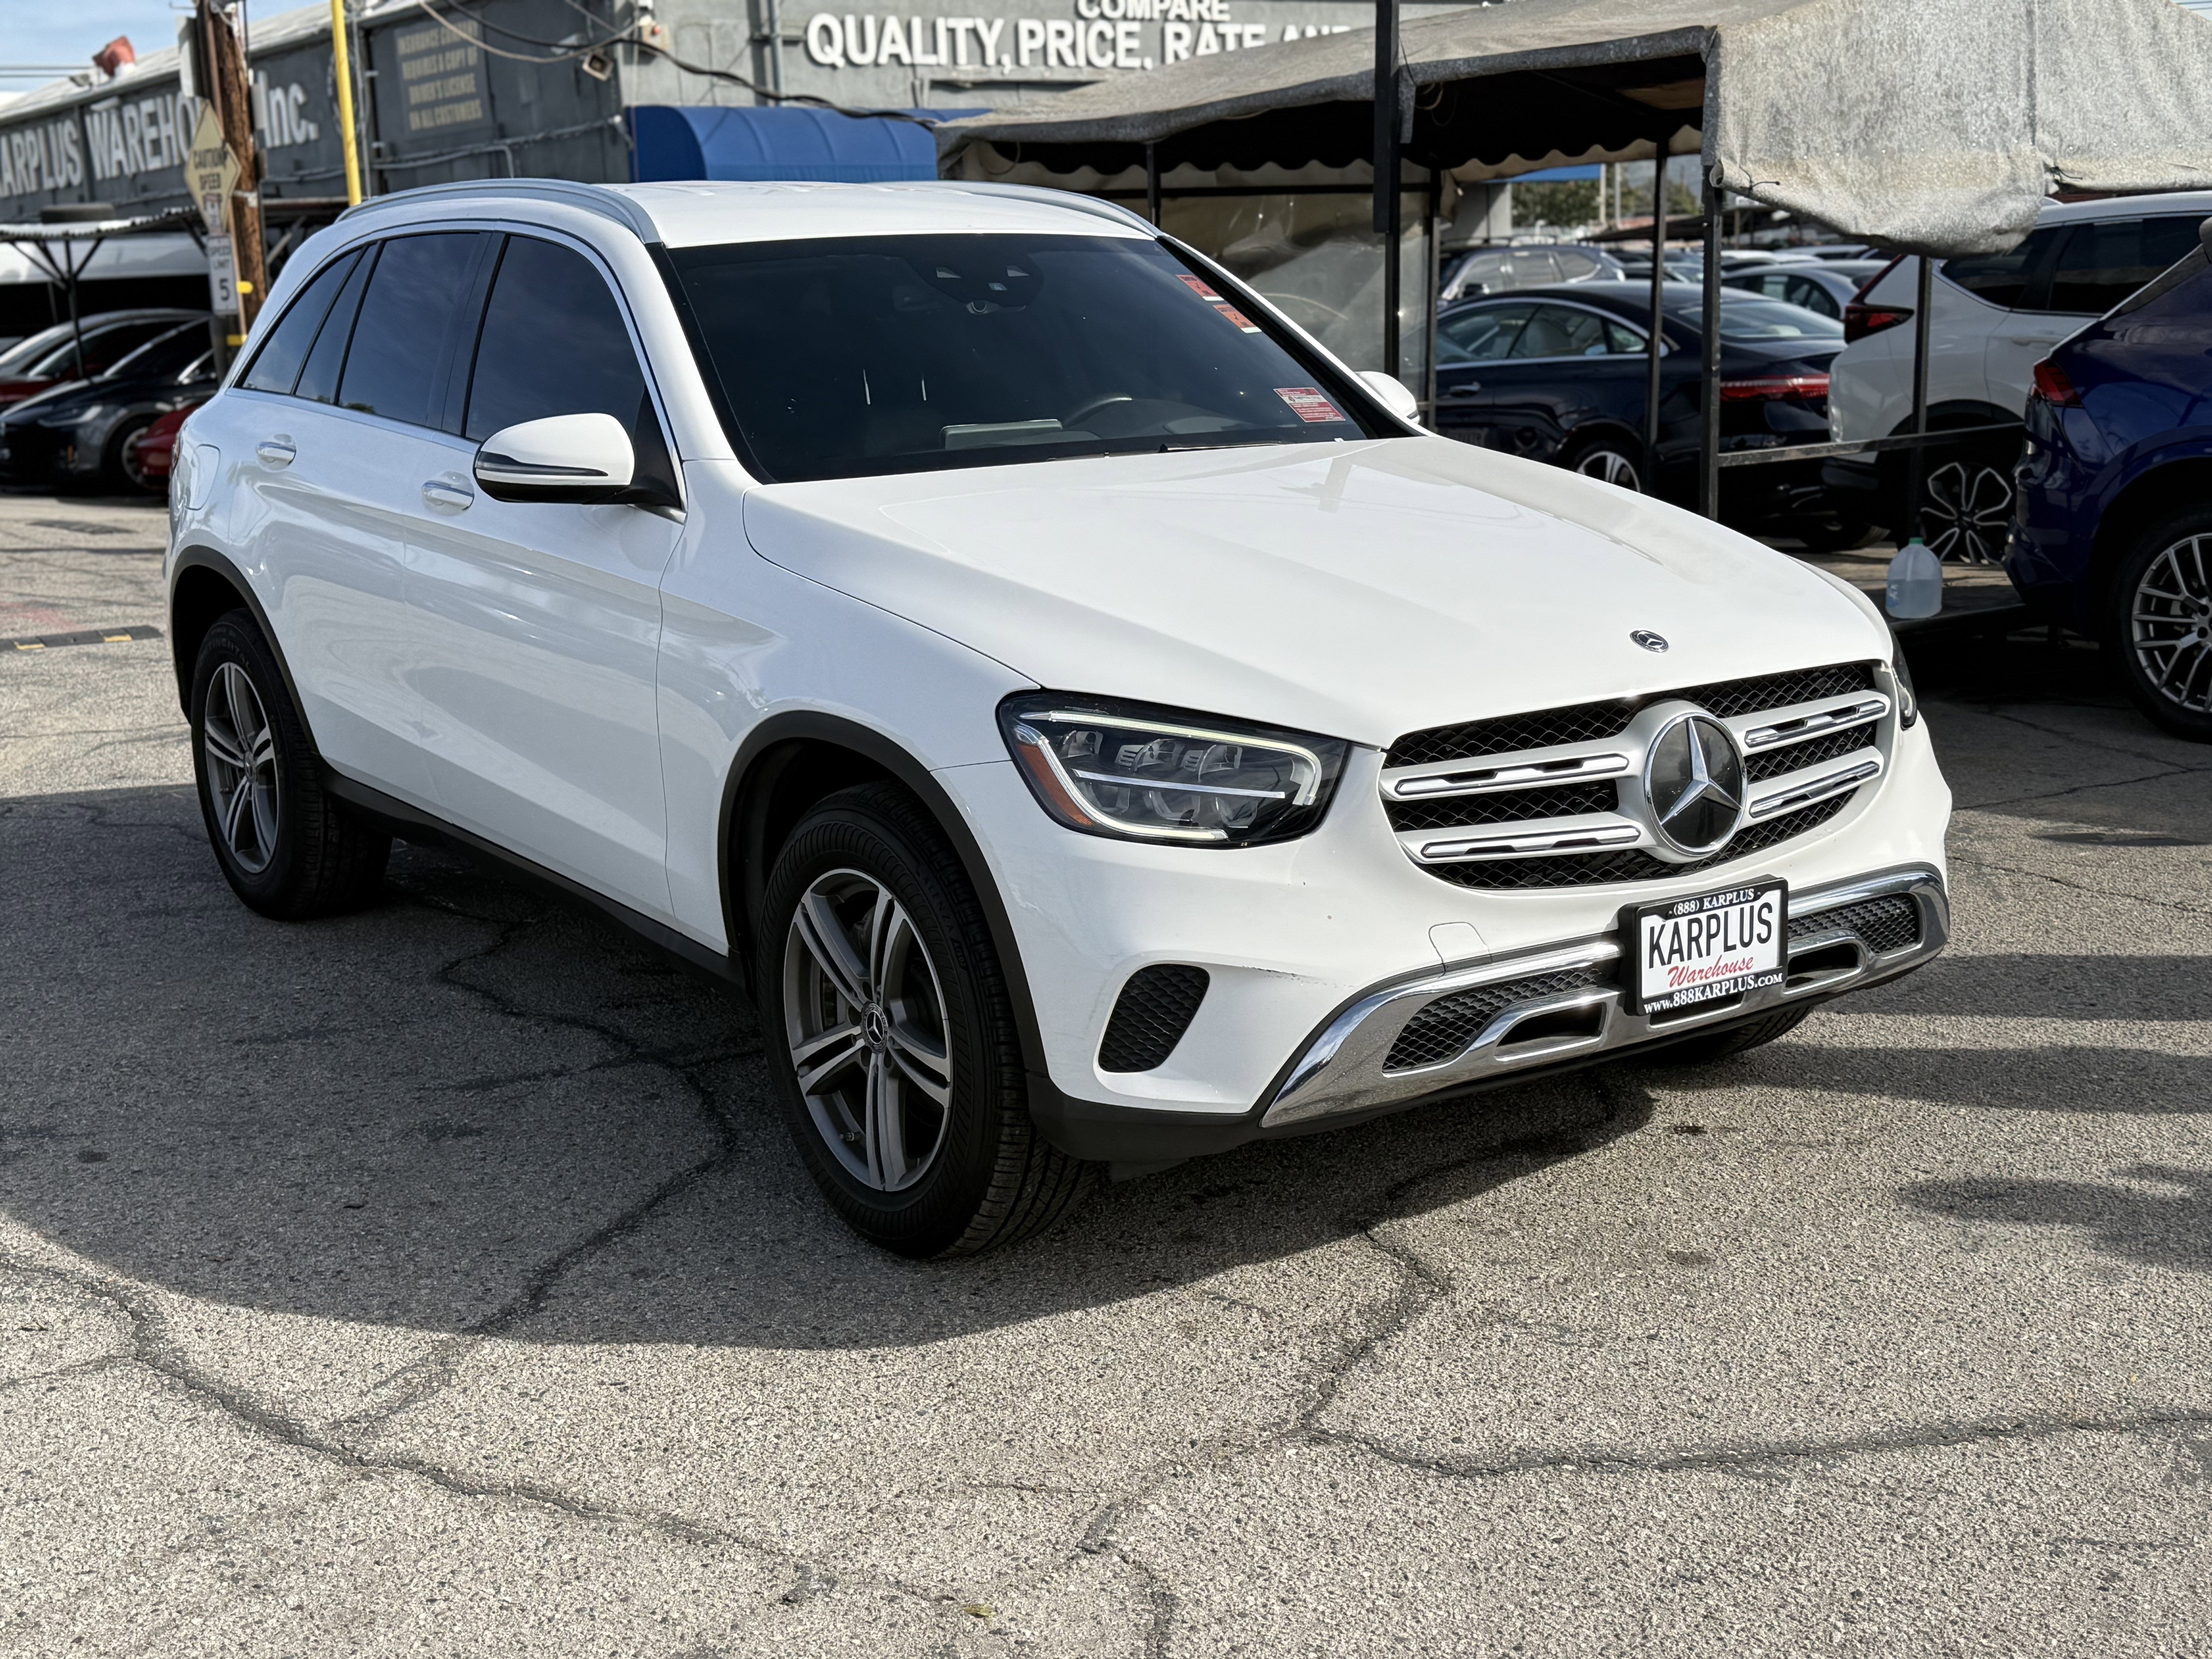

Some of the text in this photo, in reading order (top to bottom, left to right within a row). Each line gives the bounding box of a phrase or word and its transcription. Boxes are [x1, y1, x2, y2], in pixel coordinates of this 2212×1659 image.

[1076, 0, 1231, 22] COMPARE
[807, 13, 1012, 75] QUALITY,
[0, 119, 84, 199] ARPLUS
[257, 70, 319, 148] Inc.
[199, 173, 221, 190] SPEED
[210, 244, 231, 257] SPEED
[219, 278, 230, 302] 5
[1673, 888, 1754, 915] (888) KARPLUS
[1648, 902, 1773, 969] KARPLUS
[1667, 954, 1754, 988] Warehouse
